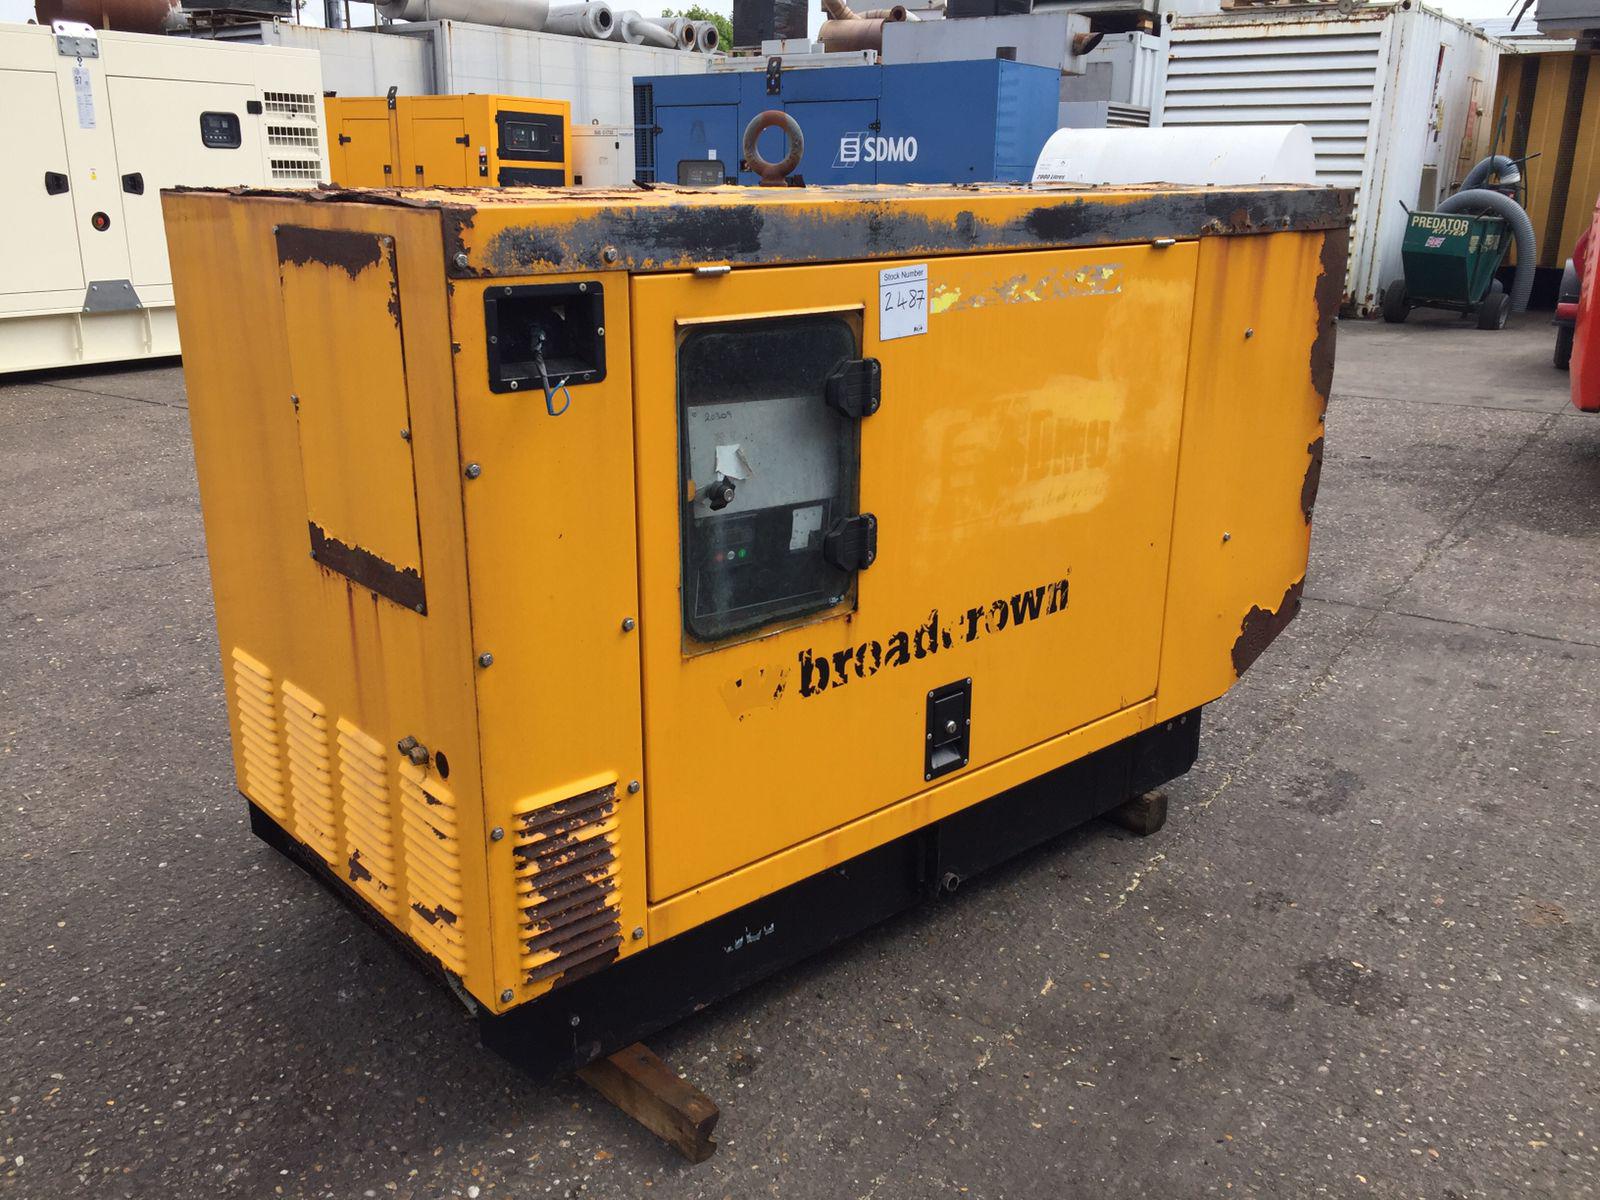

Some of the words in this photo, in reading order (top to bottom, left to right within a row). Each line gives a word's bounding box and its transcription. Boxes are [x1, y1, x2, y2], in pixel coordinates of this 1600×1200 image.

[863, 136, 919, 162] SDMO
[1411, 216, 1469, 231] PREDATOR
[884, 273, 900, 281] Stock
[901, 270, 923, 279] Number
[885, 289, 925, 311] 2487
